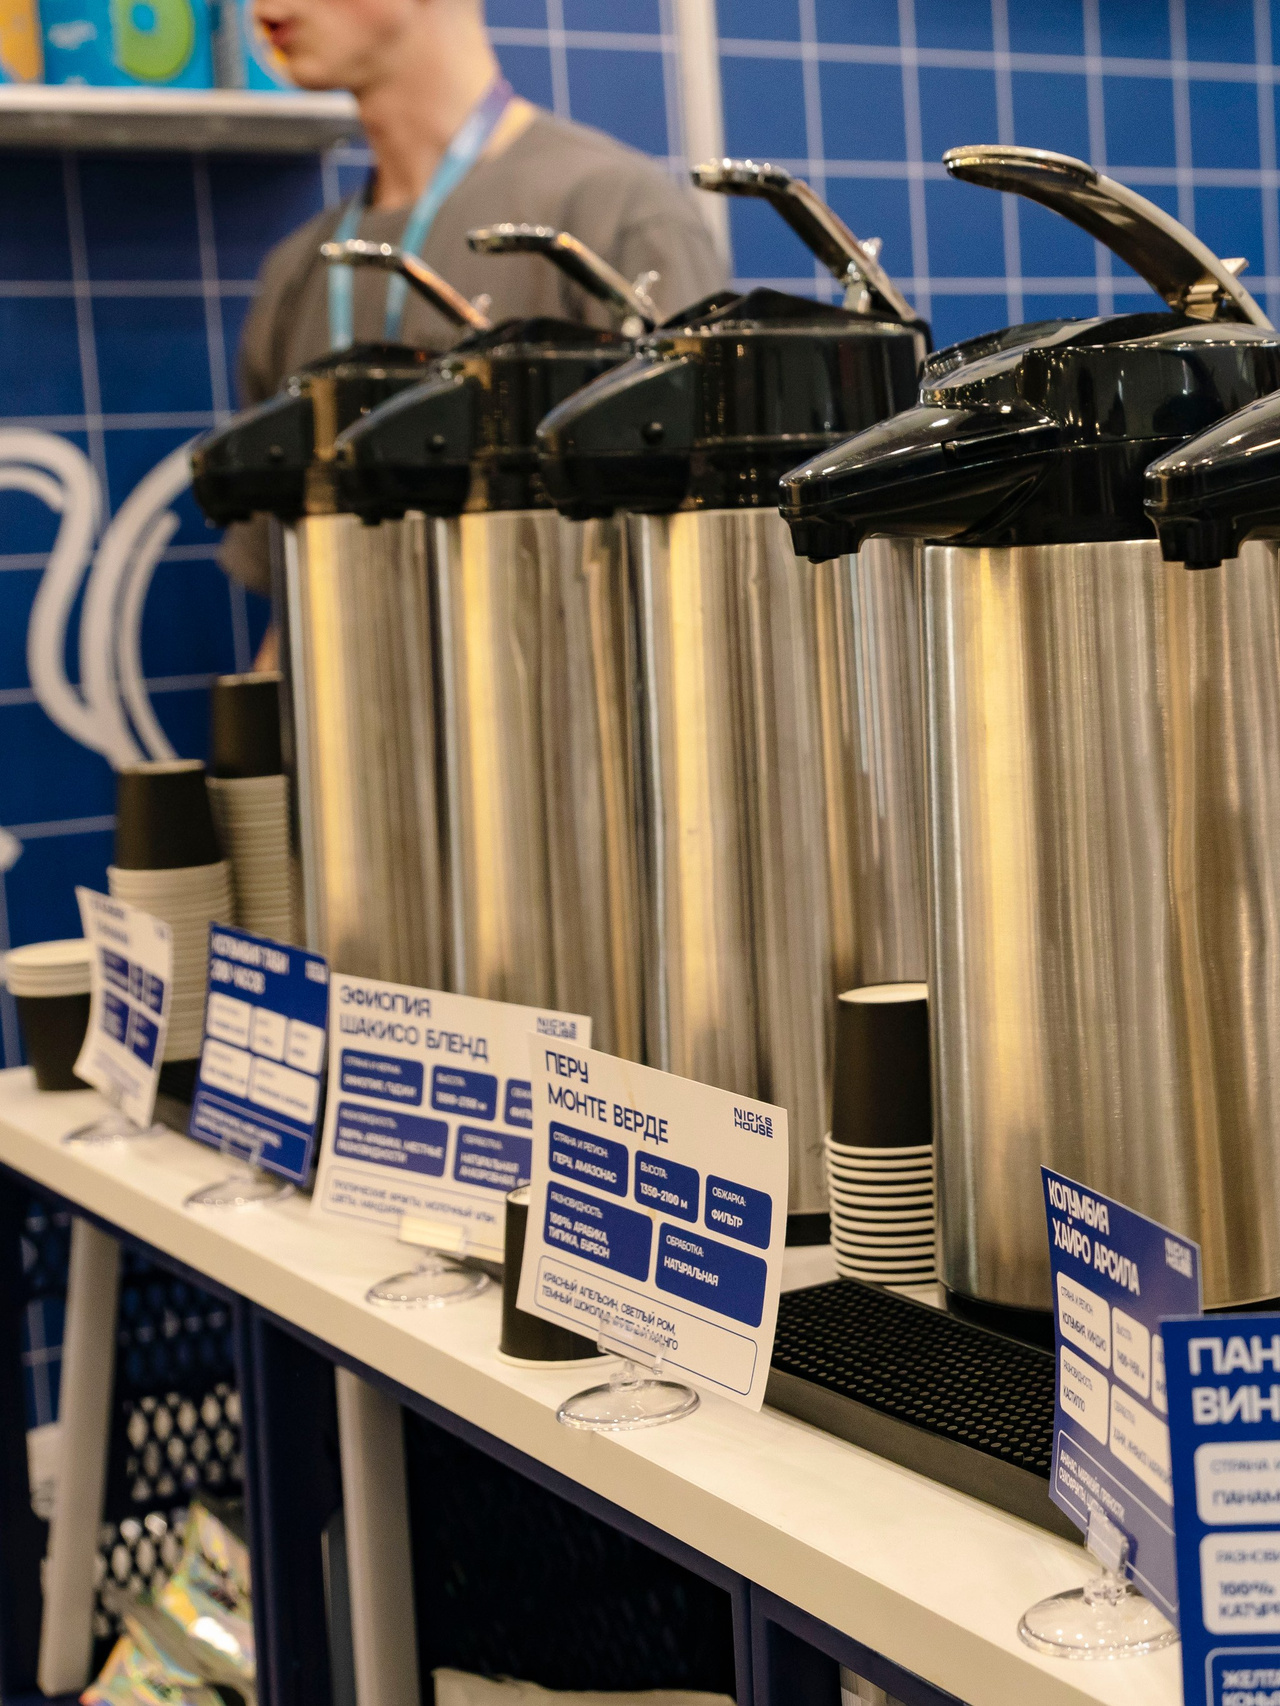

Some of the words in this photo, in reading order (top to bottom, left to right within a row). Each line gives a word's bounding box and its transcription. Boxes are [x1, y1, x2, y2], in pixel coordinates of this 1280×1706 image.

[340, 985, 431, 1018] ЭФИОПИЯ
[339, 1013, 419, 1046] ШАКИСО
[426, 1028, 488, 1062] БЛЕНД
[545, 1050, 589, 1083] ПЕРУ
[548, 1083, 607, 1122] МОНТЕ
[613, 1104, 668, 1145] ВЕРДЕ
[734, 1107, 772, 1126] NICKS
[734, 1118, 773, 1138] HOUSE
[553, 1131, 576, 1147] СТРАНА
[577, 1140, 583, 1149] И
[553, 1151, 573, 1169] ПЕРУ,
[575, 1159, 617, 1183] АМАЗОНАС
[640, 1161, 668, 1179] ВЫСОТА:
[640, 1182, 680, 1206] 1350-2100
[712, 1186, 746, 1207] ОБЖАРКА:
[1047, 1177, 1110, 1236] КОЛУМБИЯ
[550, 1211, 572, 1230] 100%
[573, 1221, 609, 1245] АРАБИКА,
[711, 1208, 743, 1228] ФИЛЬТР
[548, 1225, 579, 1249] ТИПИКА,
[580, 1238, 610, 1259] БУРБОН
[665, 1234, 704, 1257] ОБРАБОТКА:
[663, 1255, 719, 1287] НАТУРАЛЬНАЯ
[1052, 1217, 1091, 1265] ХАЙРО
[1094, 1241, 1141, 1297] АРСИЛА
[542, 1284, 572, 1305] ТЕМНЫЙ
[543, 1271, 578, 1291] КРАСНЫЙ
[580, 1285, 619, 1311] АПЕЛЬСИН,
[621, 1303, 655, 1324] СВЕТЛЫЙ
[656, 1317, 676, 1336] РОМ,
[1063, 1385, 1085, 1413] КАСТИЛЛО
[1210, 1458, 1269, 1474] СТРАНА
[1218, 1580, 1275, 1597] 100%
